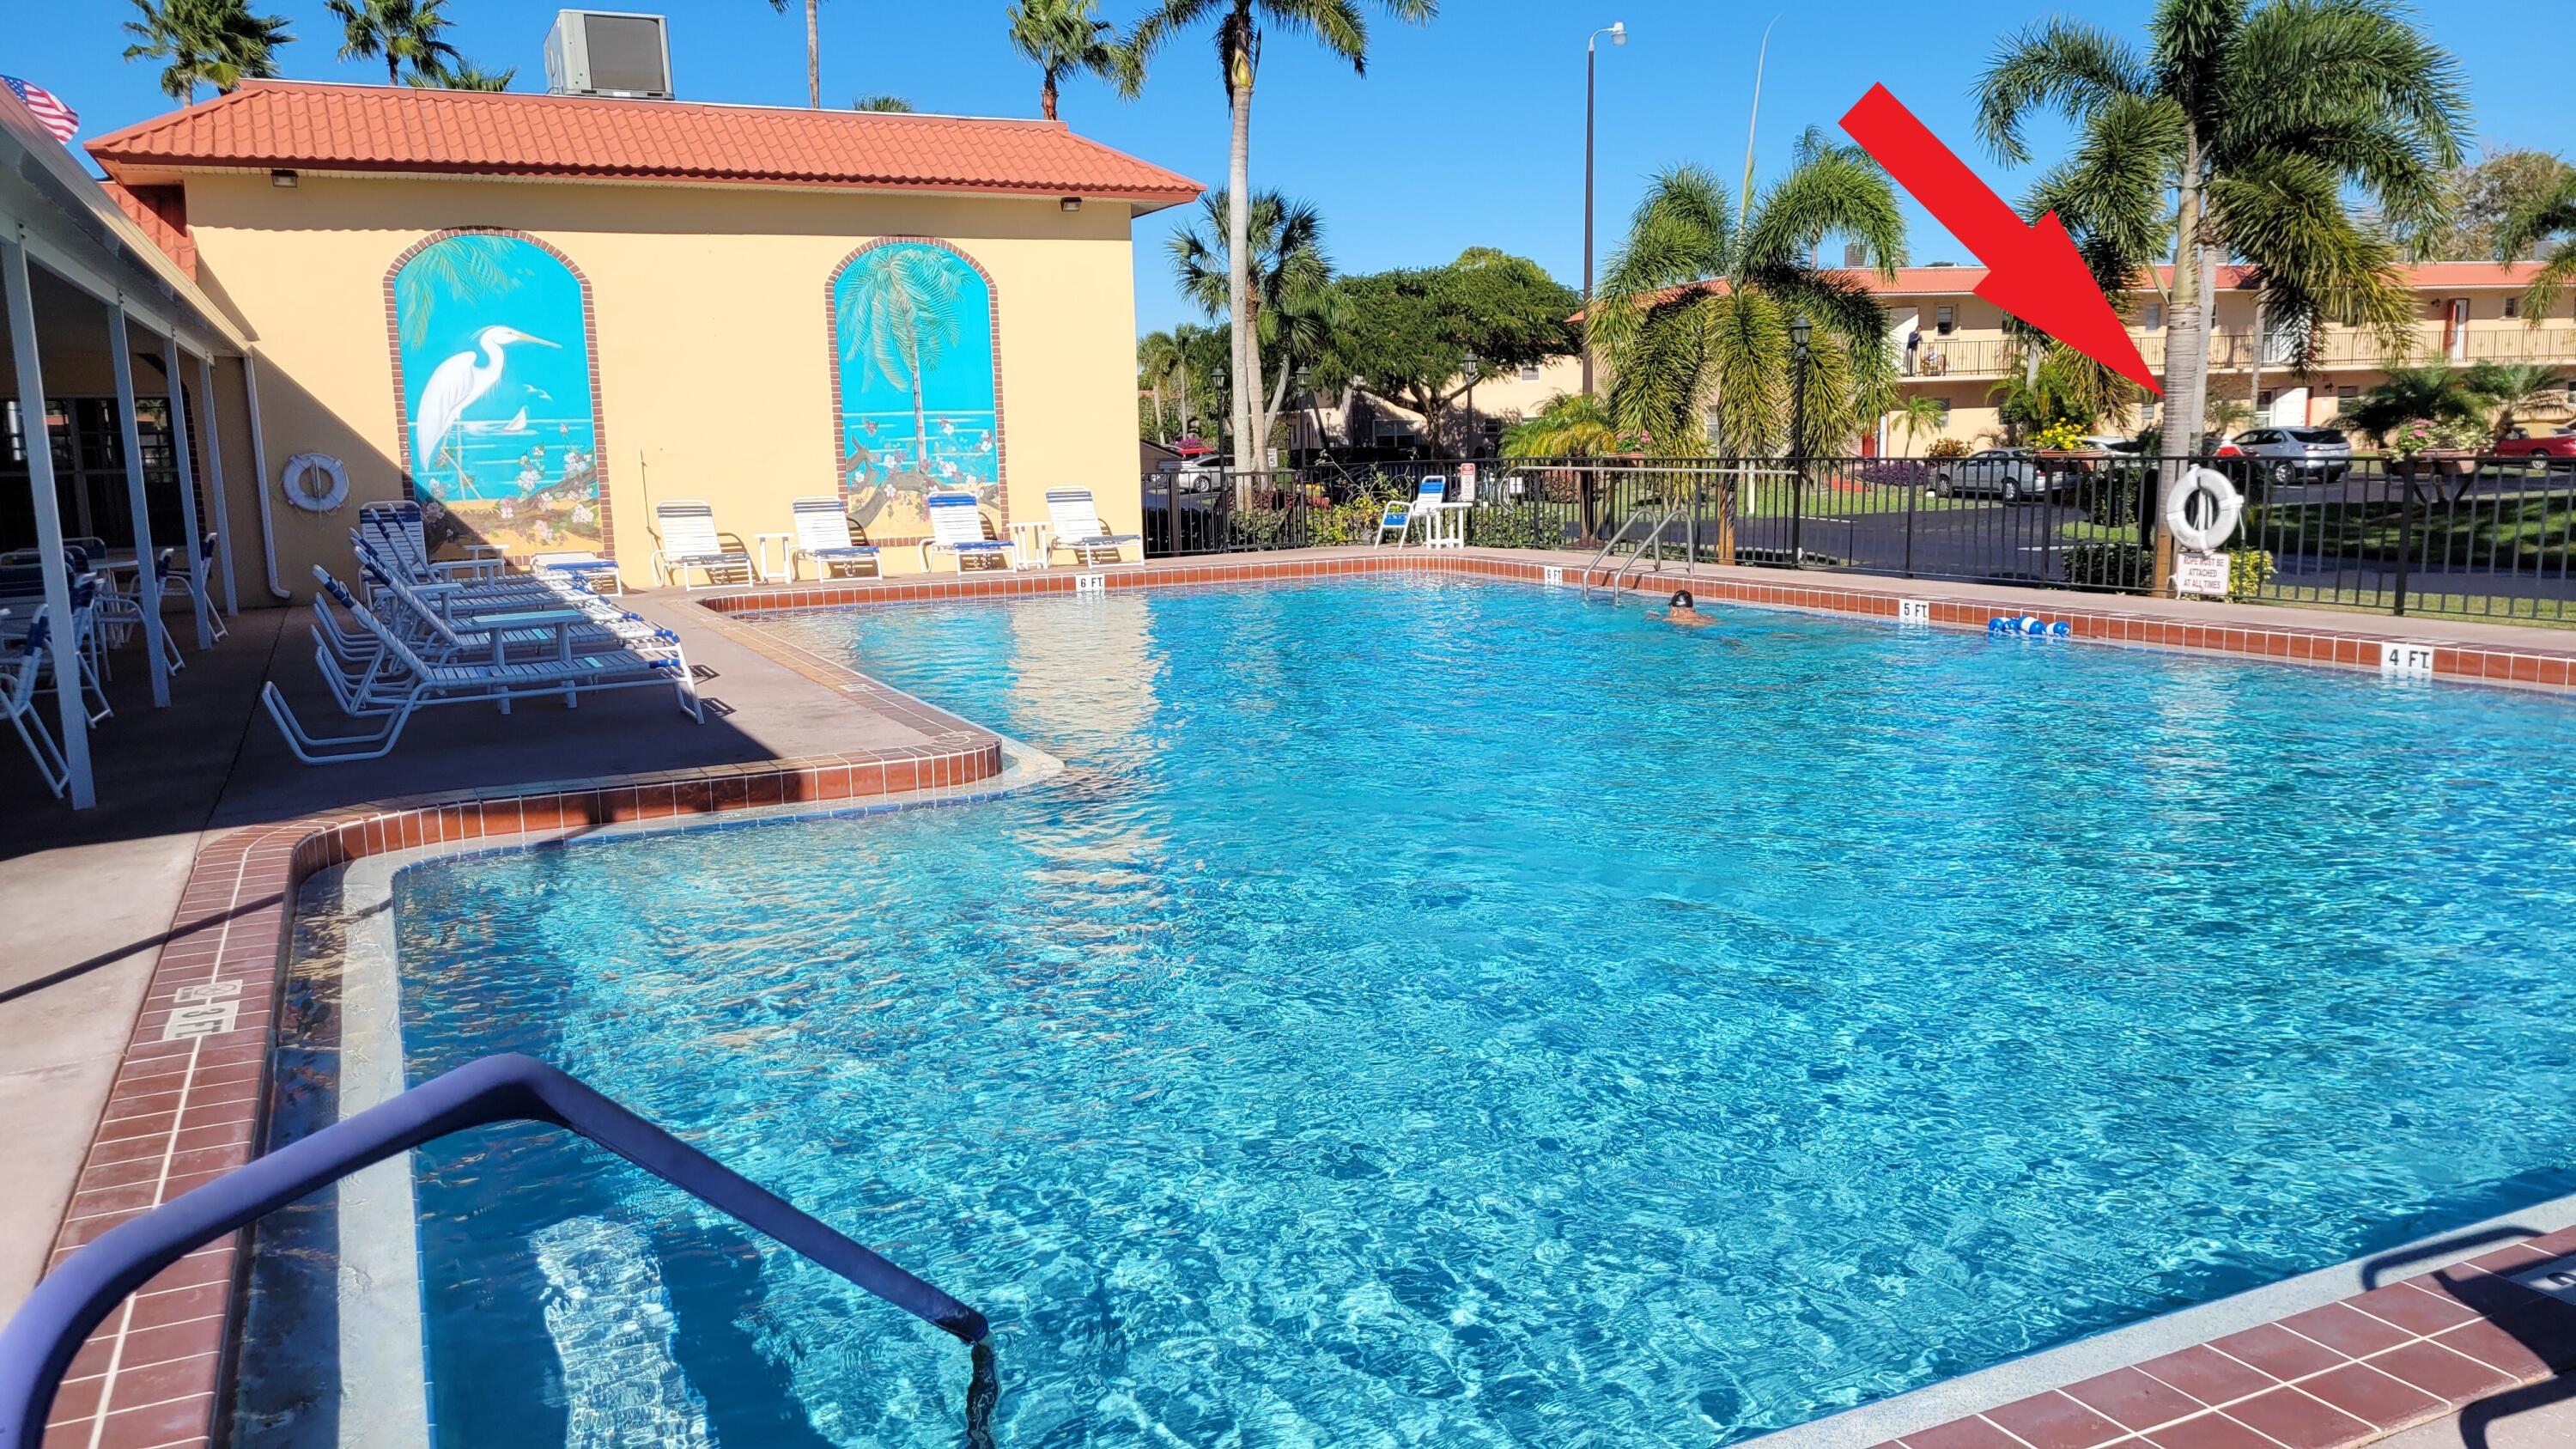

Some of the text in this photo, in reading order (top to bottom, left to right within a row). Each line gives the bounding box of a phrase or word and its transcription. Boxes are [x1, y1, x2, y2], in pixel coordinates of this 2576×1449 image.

[2216, 558, 2225, 567] BE
[2189, 568, 2217, 578] ATTACHED
[1080, 577, 1086, 588] 6
[2184, 578, 2191, 587] AT
[2203, 580, 2221, 589] TIMES
[1904, 602, 1911, 616] 5
[2389, 648, 2399, 666] 4
[181, 1008, 226, 1019] 3
